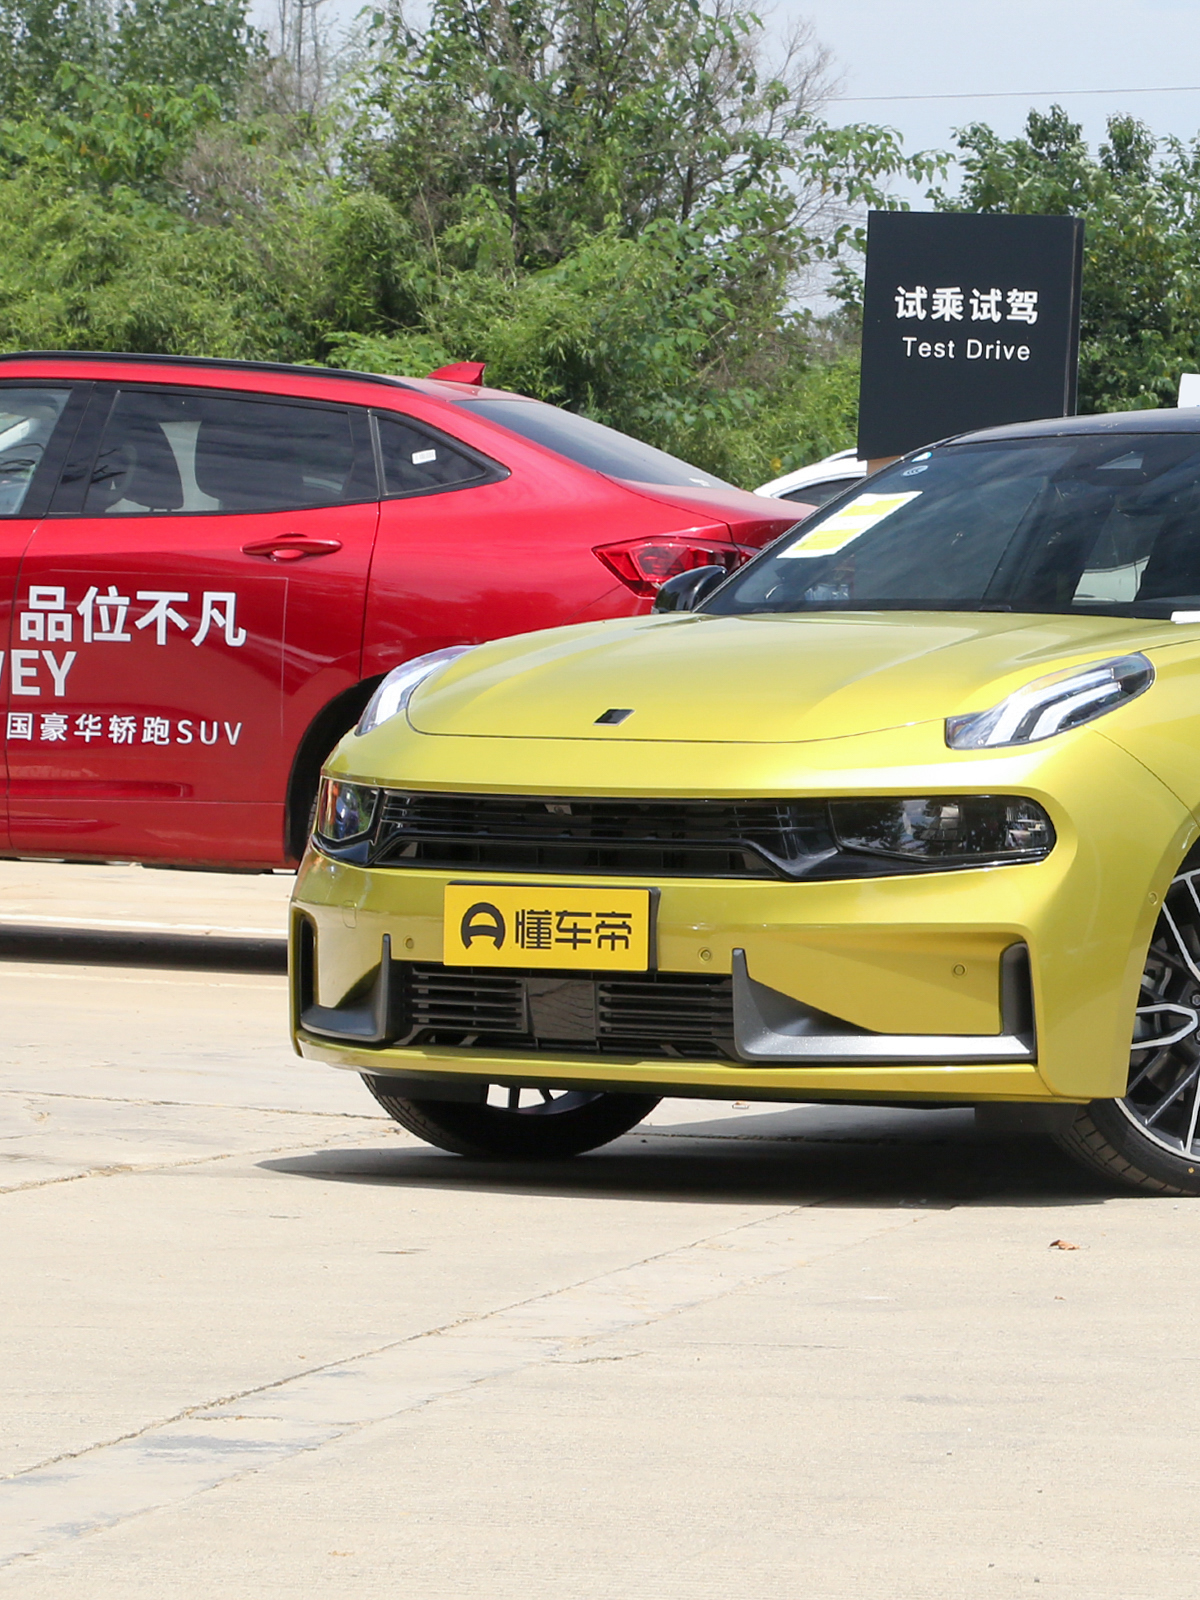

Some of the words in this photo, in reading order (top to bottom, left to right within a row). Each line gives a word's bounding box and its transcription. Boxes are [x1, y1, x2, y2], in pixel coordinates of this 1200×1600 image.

[894, 285, 1039, 325] 试乘试驾
[902, 336, 955, 360] Test
[966, 338, 1031, 361] Drive
[20, 585, 247, 647] 品位不凡
[0, 649, 77, 697] EY
[6, 712, 242, 746] 国豪华轿跑SUV
[515, 909, 632, 951] 懂车帝
